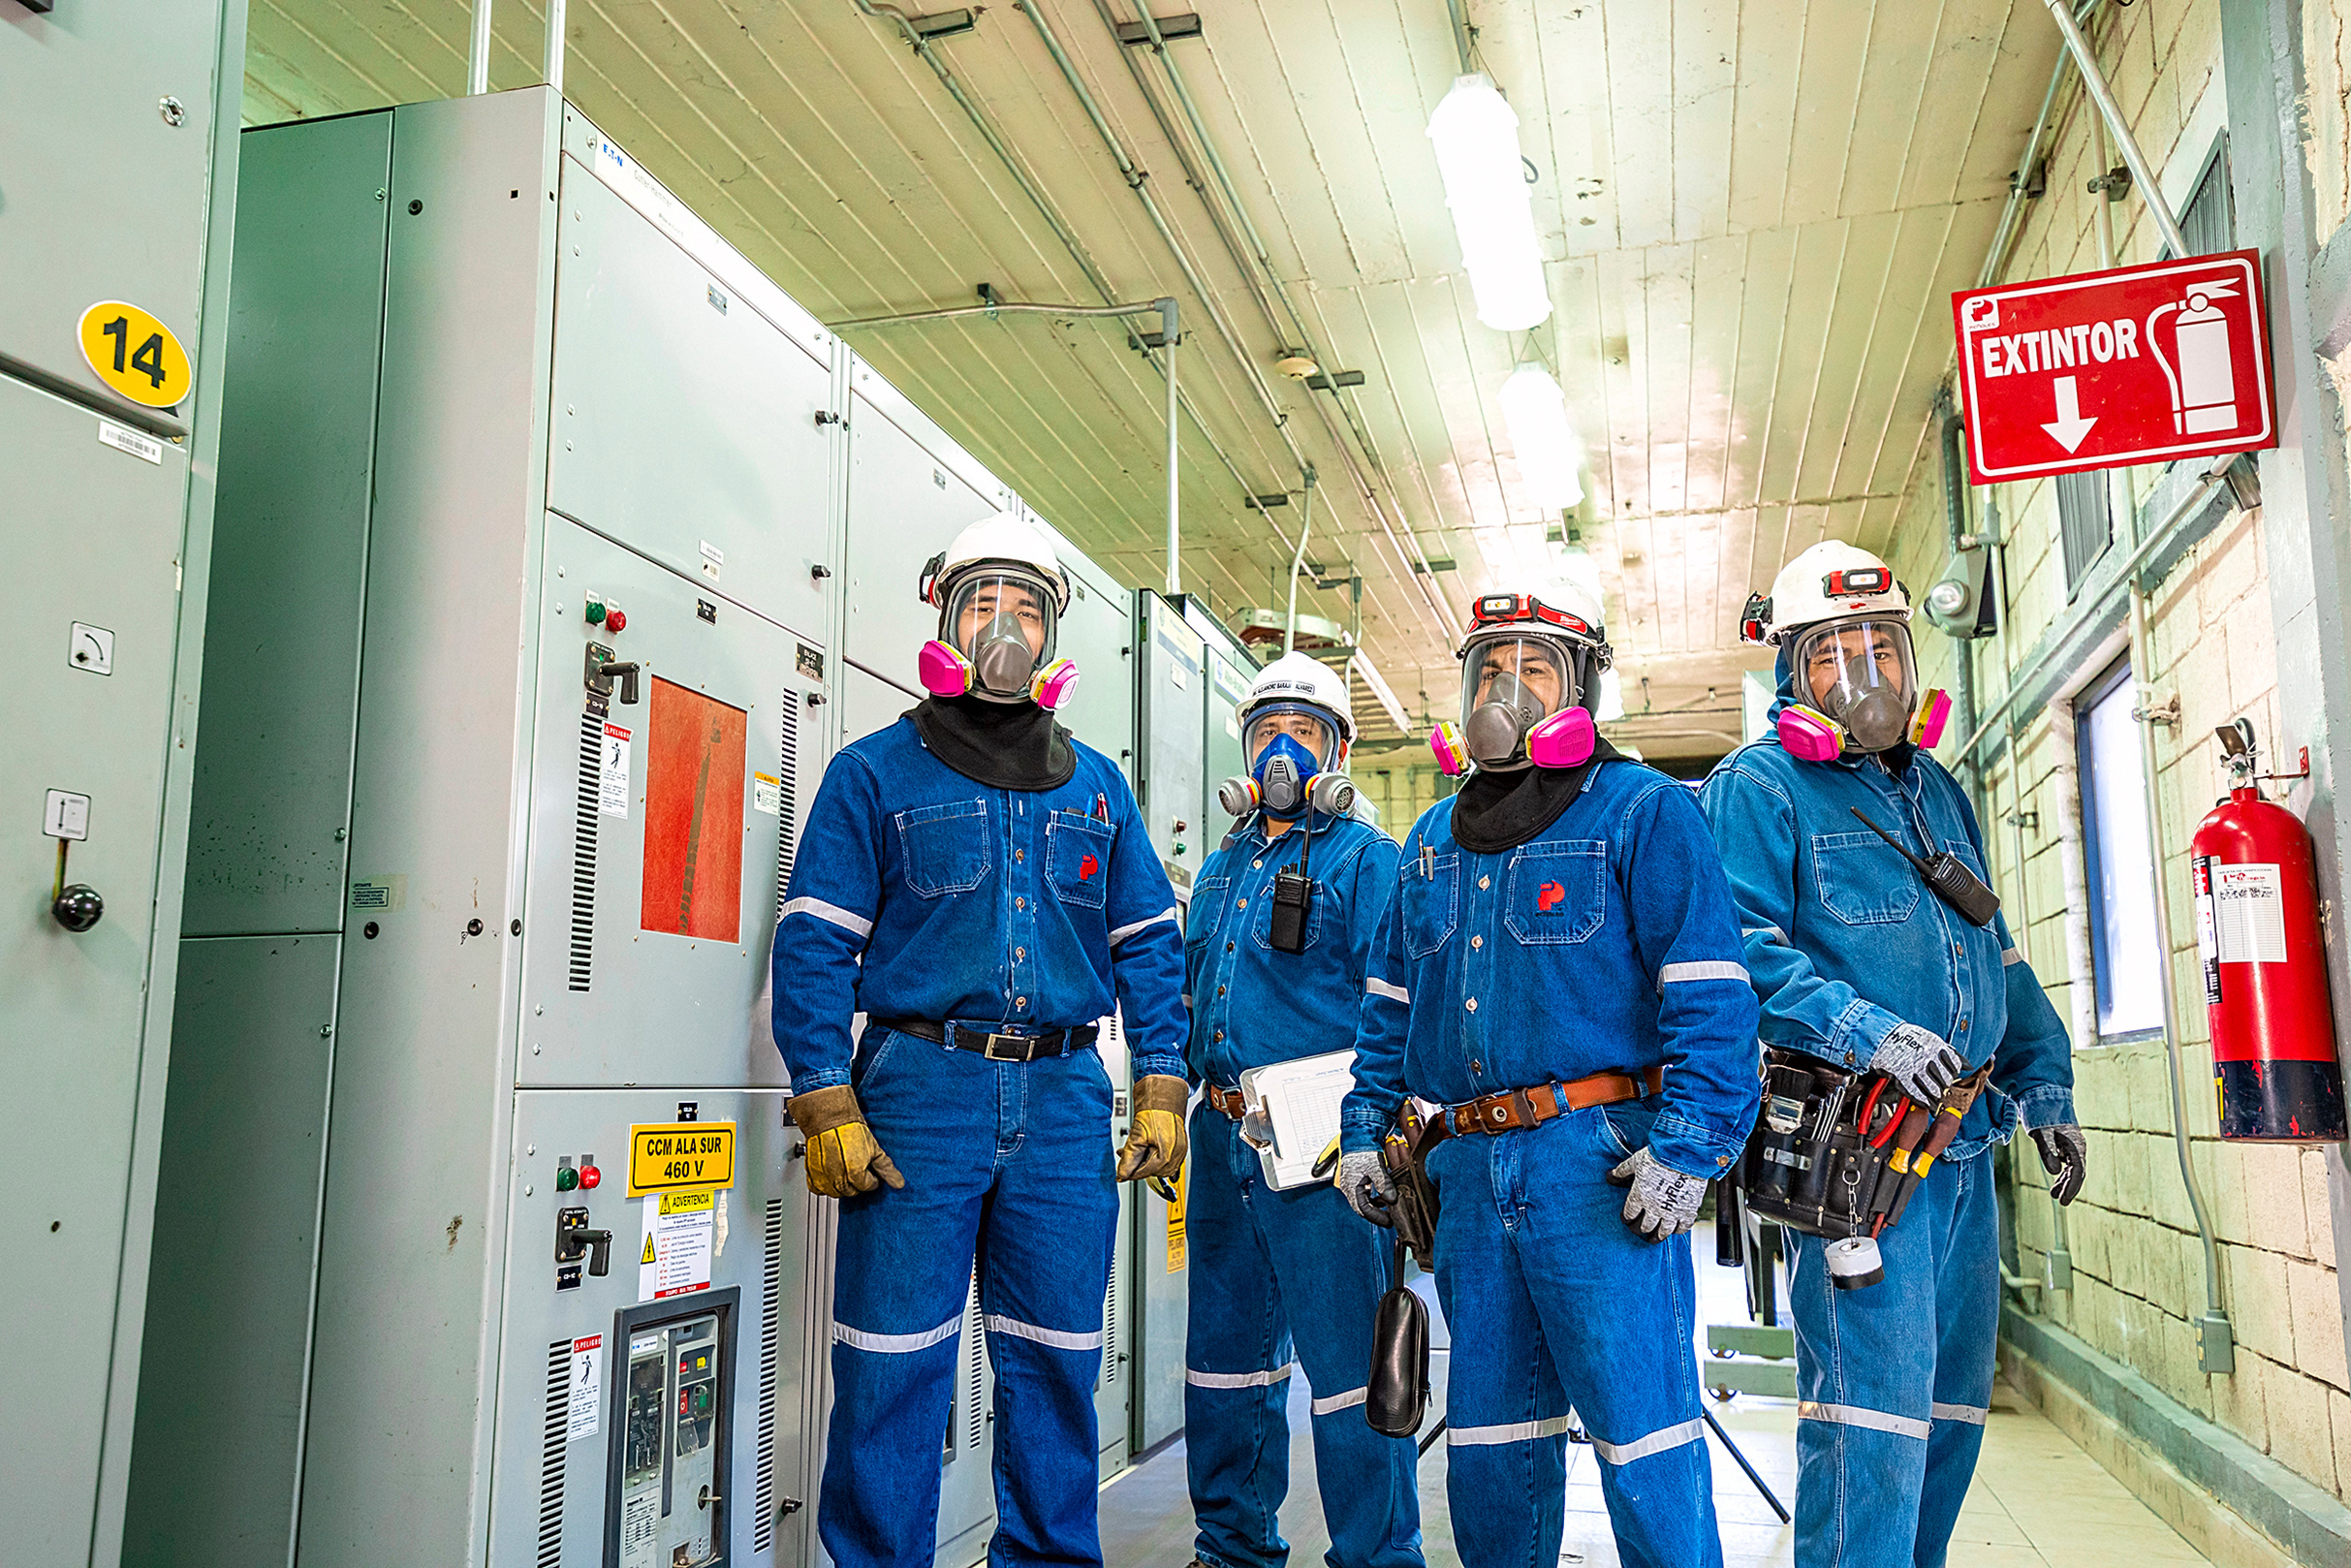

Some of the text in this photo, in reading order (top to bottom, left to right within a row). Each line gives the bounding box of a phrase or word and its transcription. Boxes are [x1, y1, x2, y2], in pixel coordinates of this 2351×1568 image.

[103, 316, 166, 390] 14
[1981, 318, 2140, 378] EXTINTOR
[610, 727, 630, 739] PELIGRO
[647, 1137, 722, 1156] CCM ALA SUR
[664, 1160, 705, 1179] 460 V
[672, 1193, 710, 1207] ADVERTENCIA
[1660, 1174, 1689, 1211] HyFlex
[580, 1337, 602, 1349] PELIGRO
